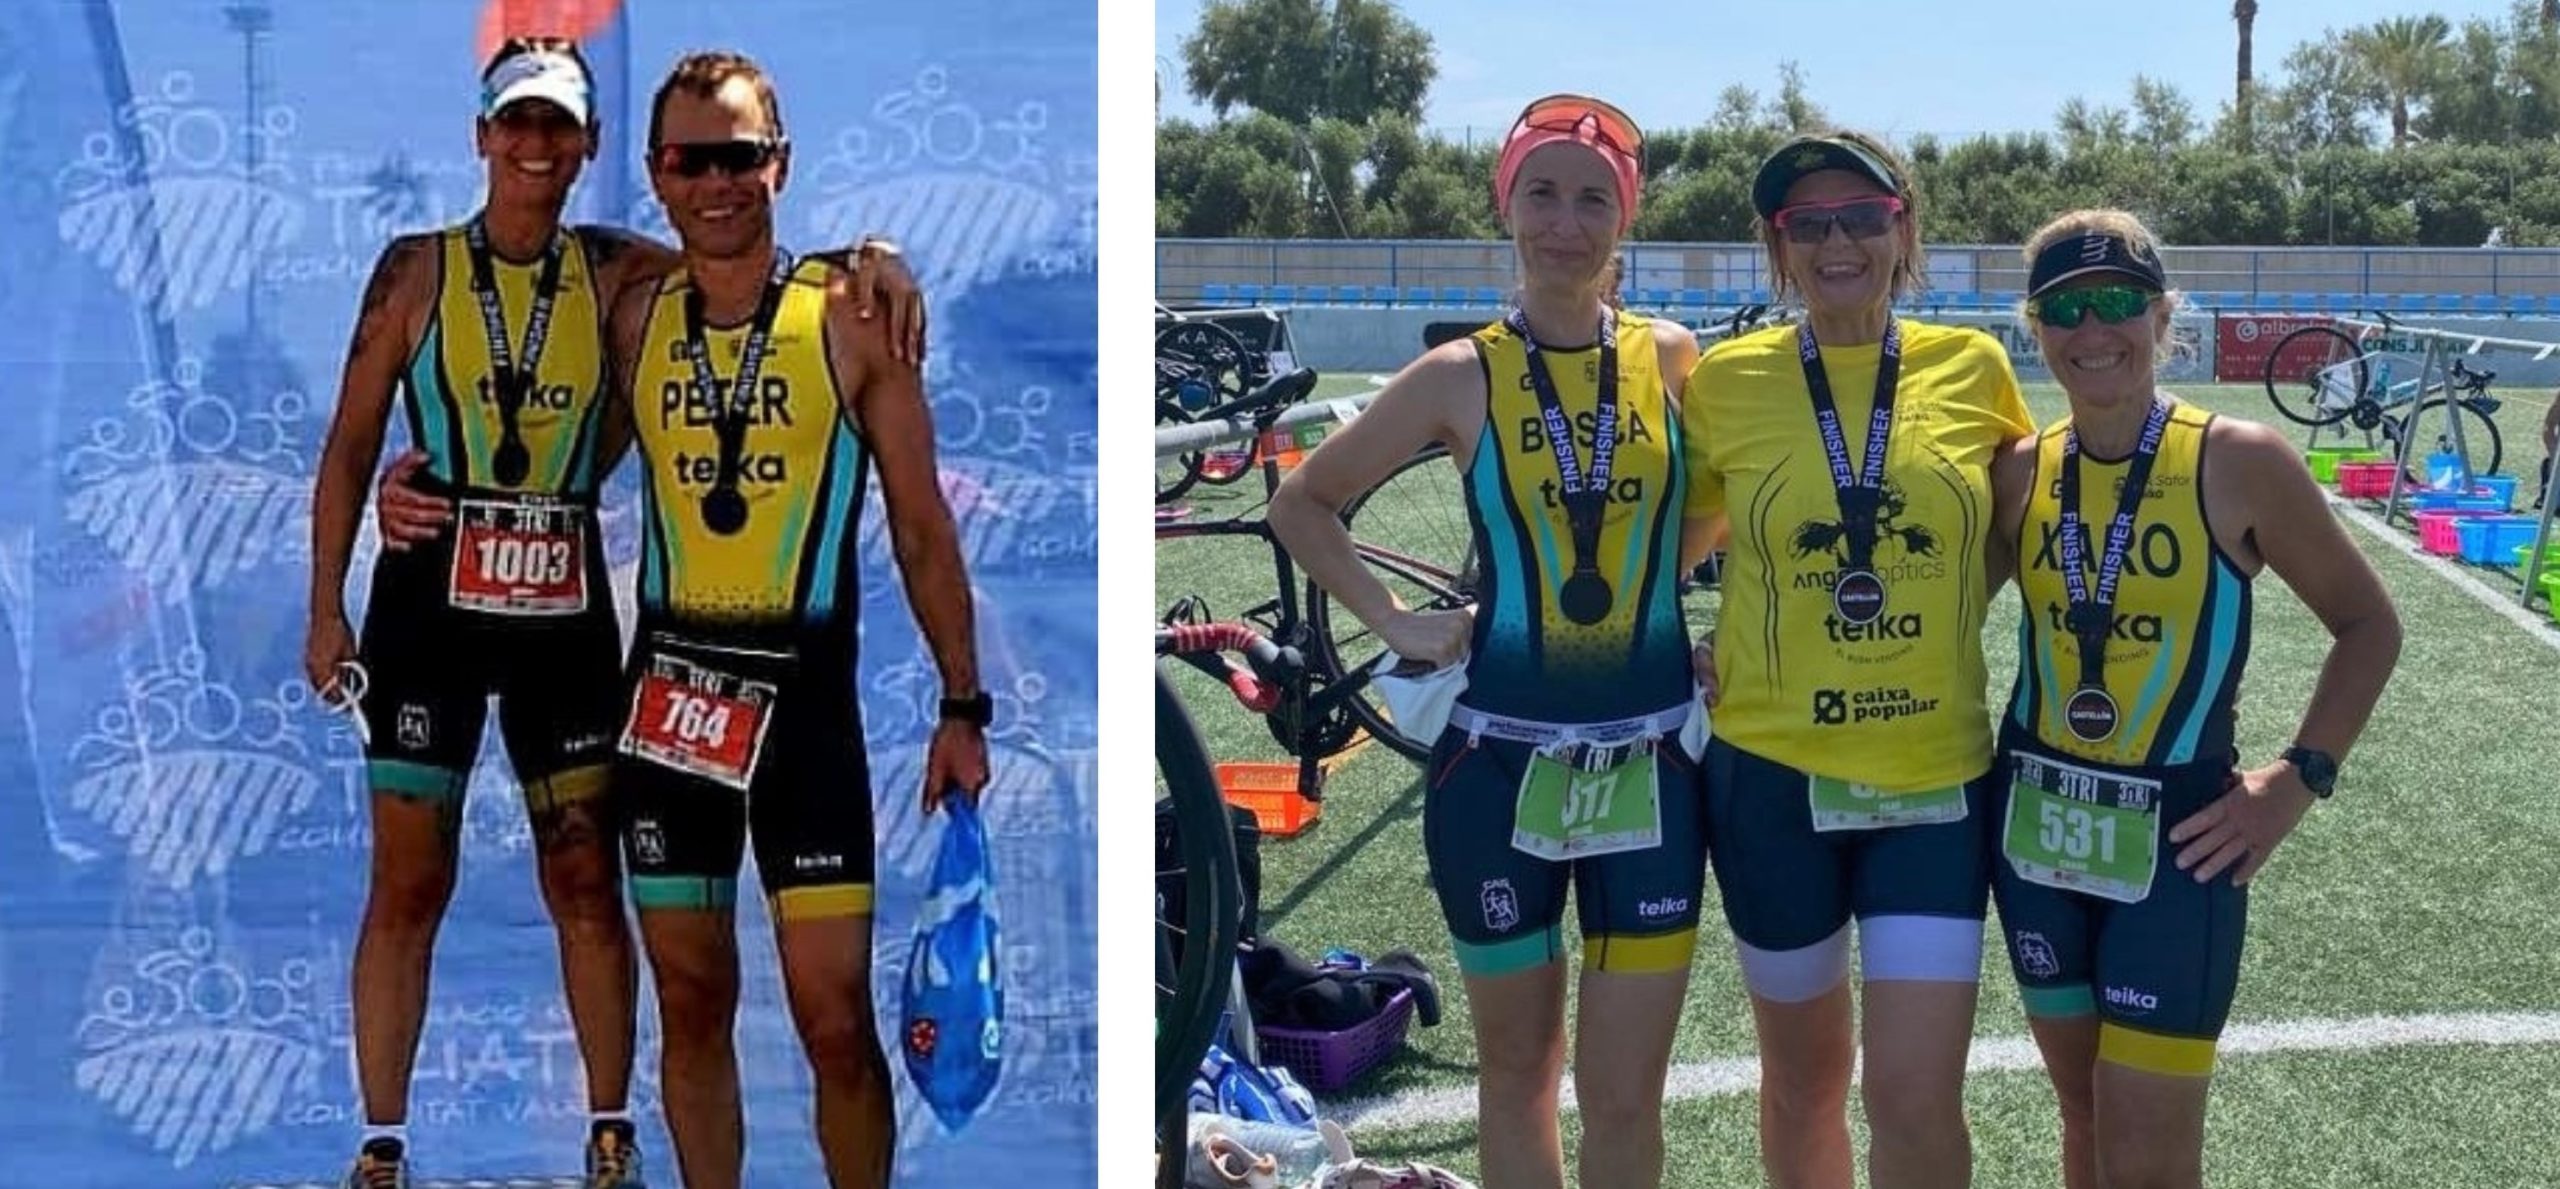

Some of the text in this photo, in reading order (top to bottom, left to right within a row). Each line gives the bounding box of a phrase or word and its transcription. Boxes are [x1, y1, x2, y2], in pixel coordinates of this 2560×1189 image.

[1544, 405, 1581, 494] FINISHER
[1590, 402, 1615, 492] FINISHER
[1818, 409, 1853, 489] FINISHER
[1863, 408, 1891, 489] FINISHER
[2139, 400, 2168, 455] FINIS
[674, 451, 787, 484] teka
[1540, 474, 1643, 508] tka
[477, 537, 571, 584] 1003
[2062, 511, 2087, 602] FINISHER
[2097, 512, 2134, 605] FINISHER
[1823, 612, 1922, 643] teika
[2048, 601, 2163, 643] tka
[660, 690, 732, 748] 764
[1852, 687, 1911, 704] caixa
[1853, 698, 1940, 723] popular
[2058, 770, 2099, 804] 3TRI
[2039, 800, 2116, 864] 531
[1638, 897, 1688, 916] teika
[2105, 985, 2158, 1010] teika
